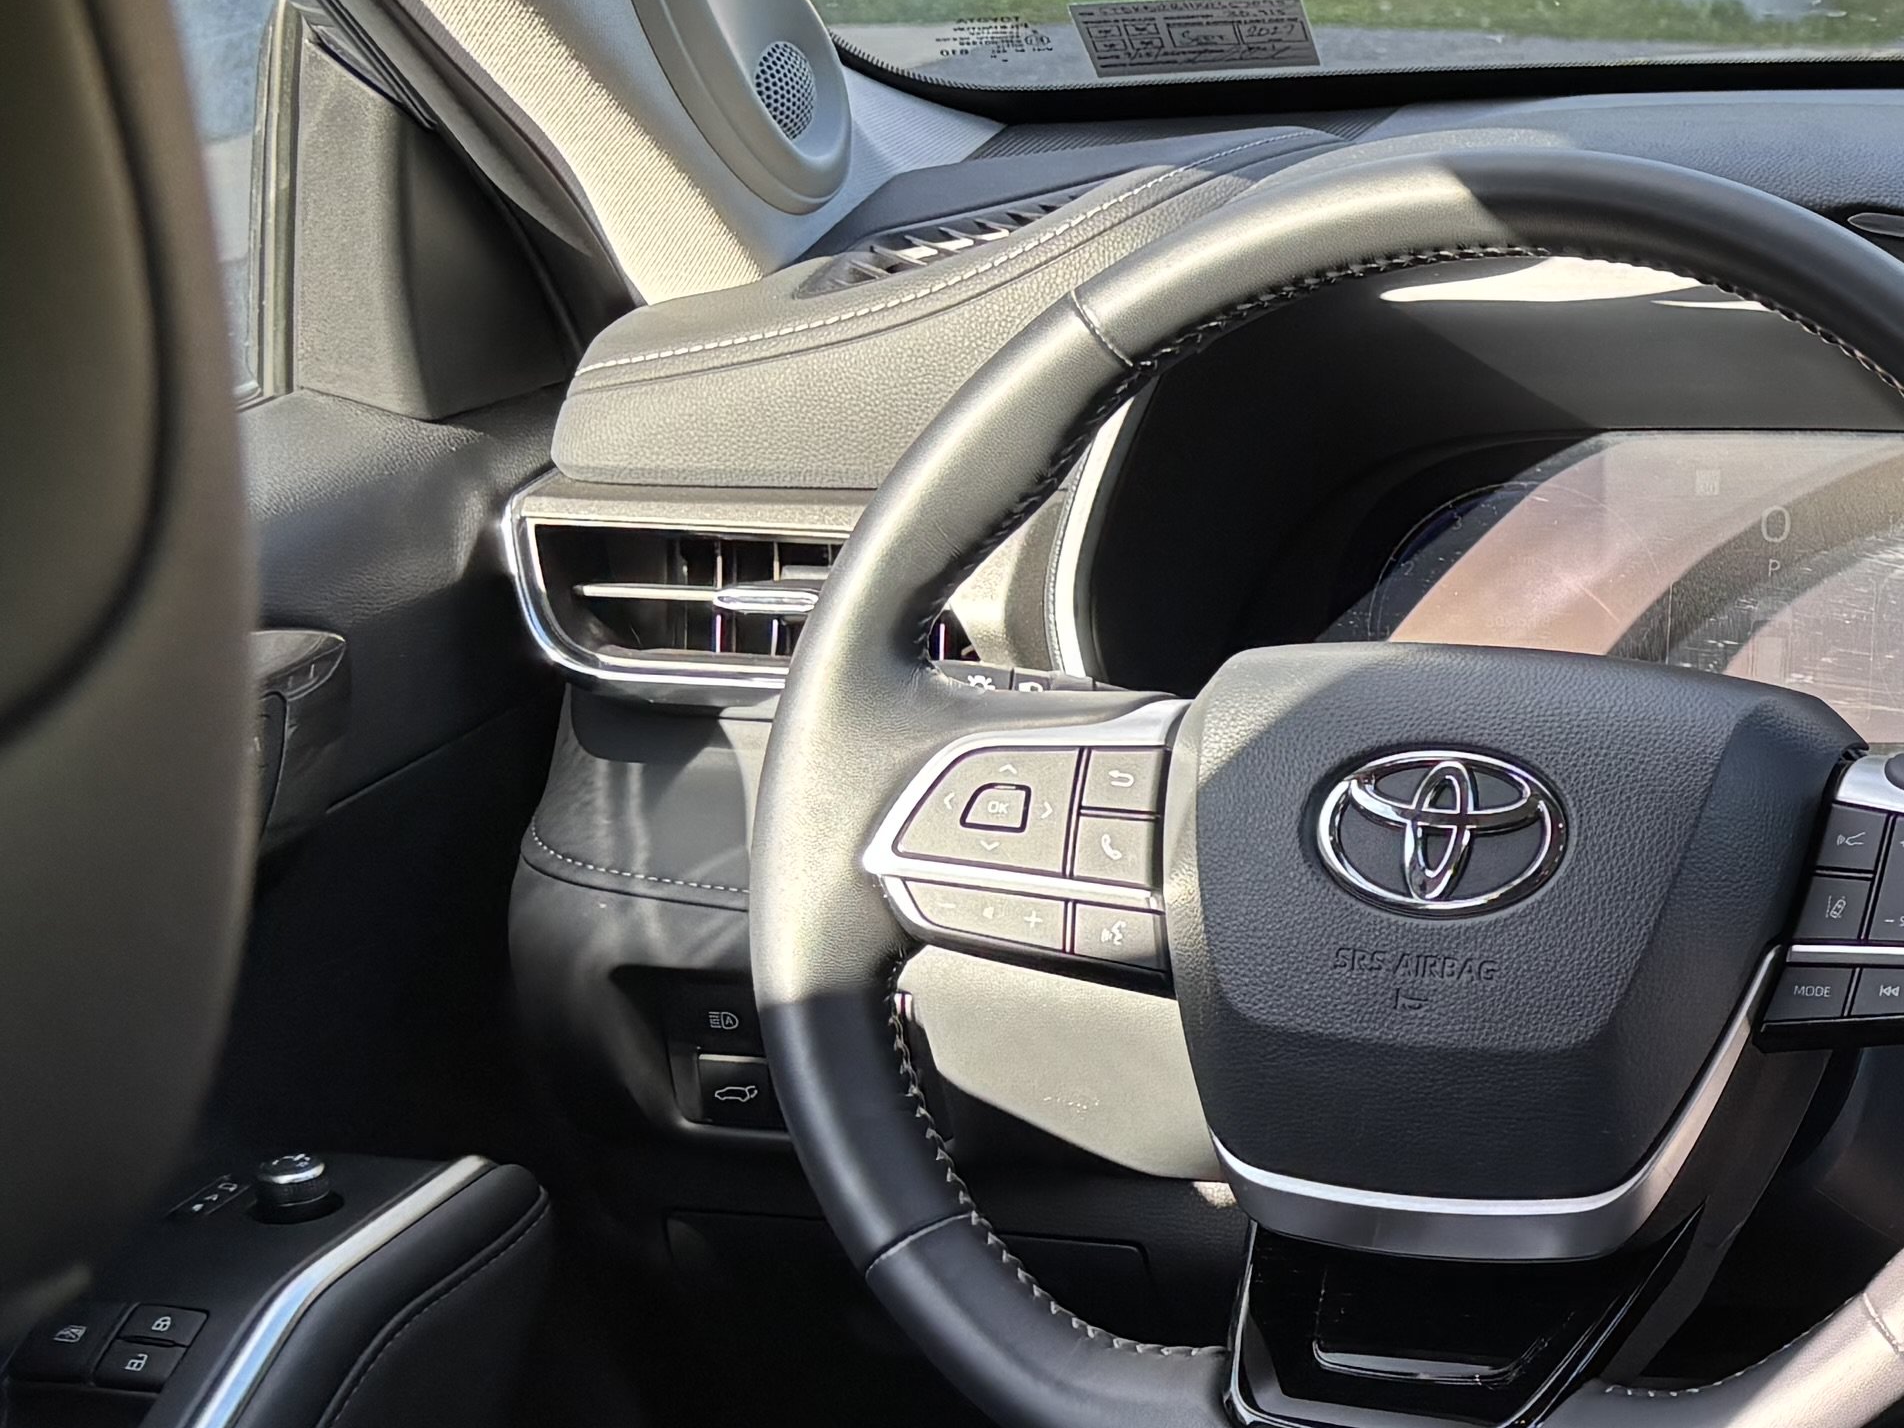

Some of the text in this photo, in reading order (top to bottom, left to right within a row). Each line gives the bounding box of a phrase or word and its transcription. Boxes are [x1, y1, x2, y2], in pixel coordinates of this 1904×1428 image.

[1760, 505, 1791, 543] 0
[1768, 558, 1781, 577] P
[987, 800, 1009, 814] OK
[1334, 947, 1498, 981] SRS AIRBAG
[1793, 985, 1831, 997] MODE
